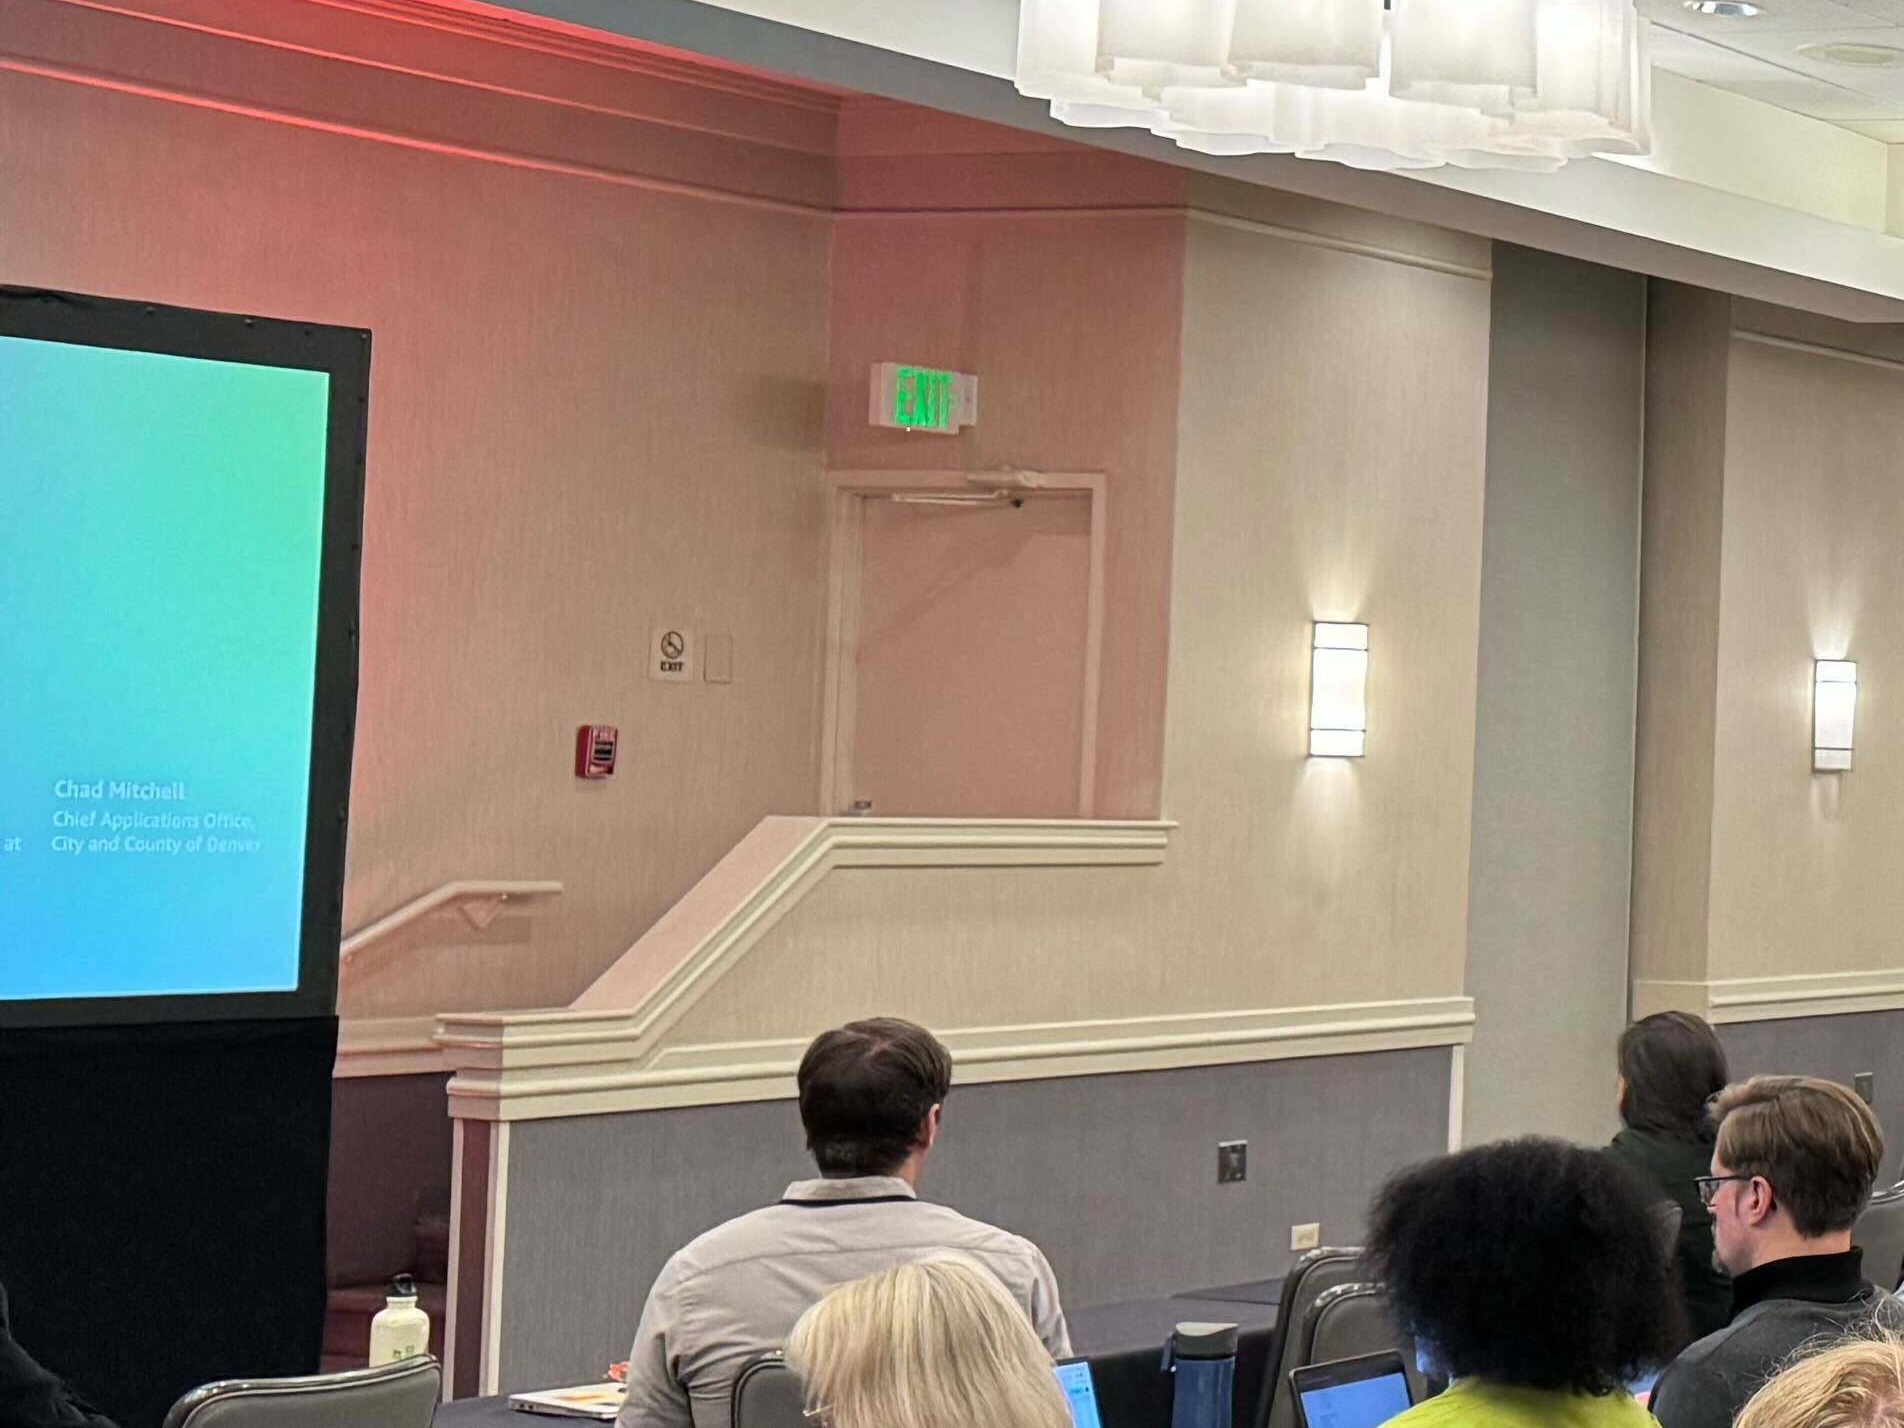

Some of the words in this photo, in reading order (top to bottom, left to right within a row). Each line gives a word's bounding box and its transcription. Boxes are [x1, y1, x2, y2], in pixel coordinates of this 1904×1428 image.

[896, 367, 951, 429] EXIT
[660, 660, 684, 672] EXIT
[54, 779, 103, 799] Chad
[108, 780, 187, 801] Mitchell
[53, 810, 97, 828] Chief
[100, 811, 200, 831] Applications
[51, 835, 84, 856] City
[88, 835, 119, 852] and
[123, 835, 181, 856] County
[185, 835, 203, 853] of
[207, 836, 262, 854] Denver
